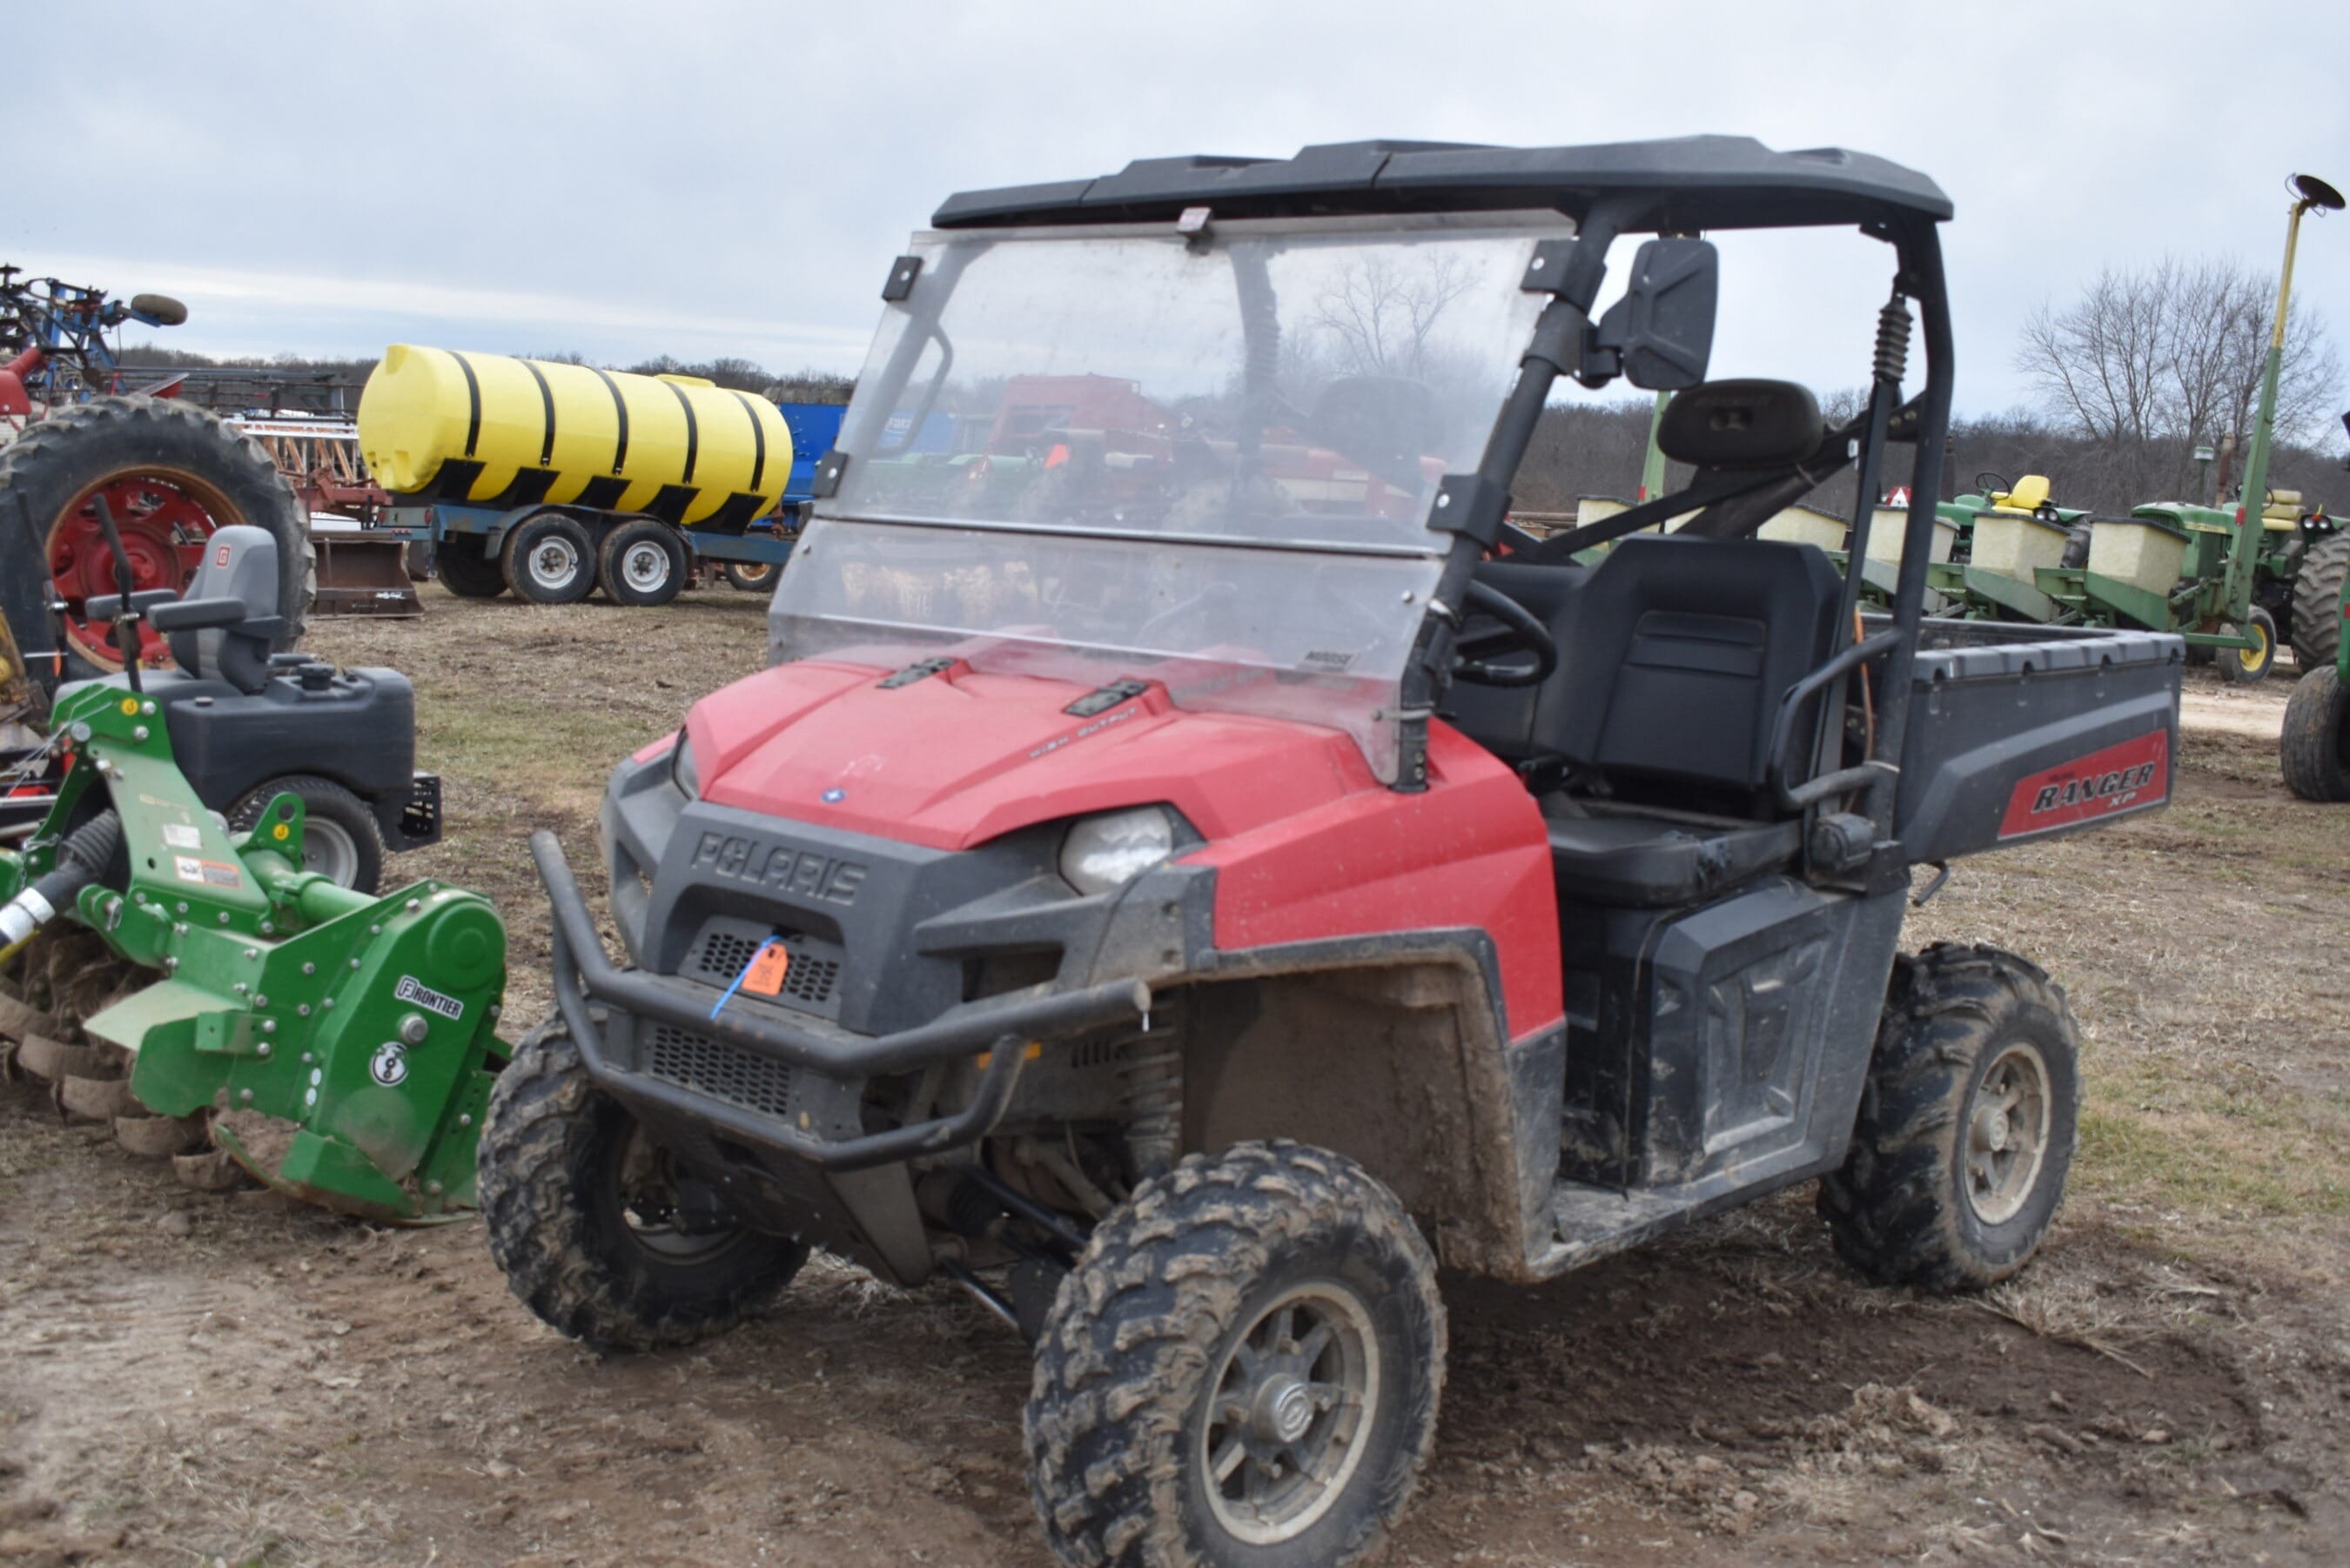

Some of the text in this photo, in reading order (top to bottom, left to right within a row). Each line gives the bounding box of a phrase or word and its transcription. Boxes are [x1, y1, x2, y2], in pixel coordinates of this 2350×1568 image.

[2031, 762, 2154, 814] RANGER
[2107, 791, 2137, 808] XP
[690, 832, 869, 906] POLARIS
[397, 976, 463, 1018] FRONTIER
